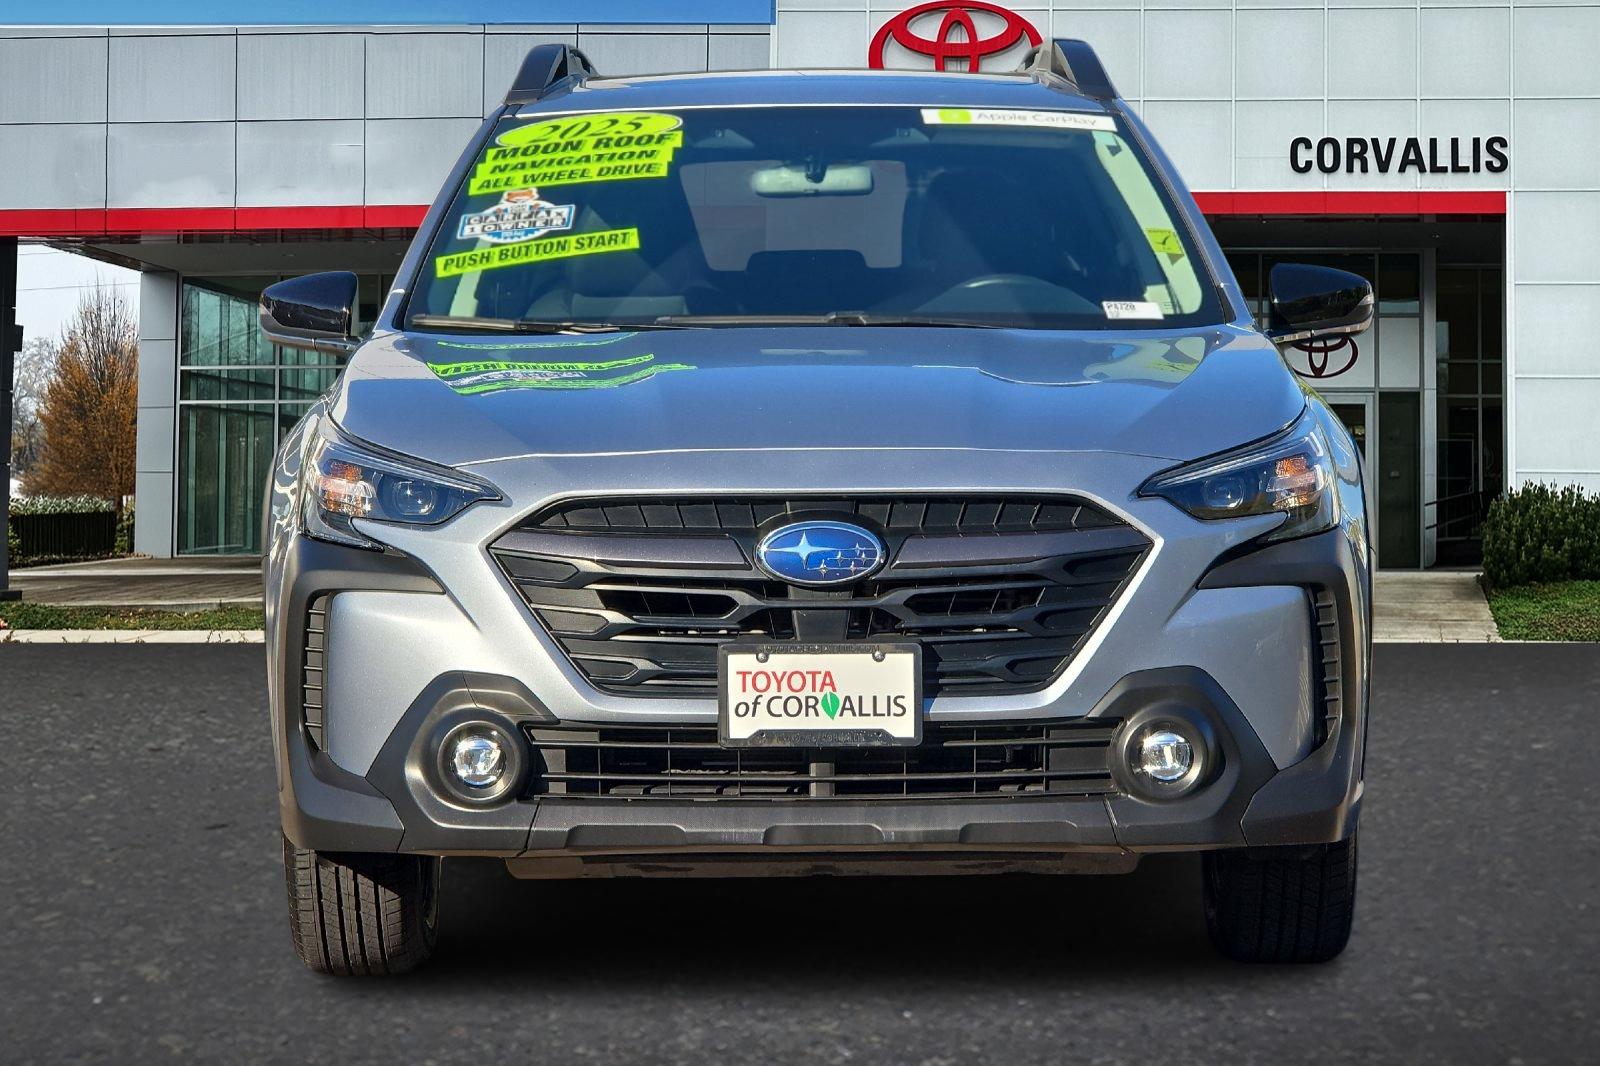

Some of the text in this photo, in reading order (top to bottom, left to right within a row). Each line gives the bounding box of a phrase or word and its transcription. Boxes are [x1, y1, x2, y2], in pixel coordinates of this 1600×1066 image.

[529, 116, 651, 143] 2025
[977, 113, 1097, 125] Apple CarPlay
[492, 132, 674, 161] MOON ROOF
[1290, 136, 1509, 174] CORVALLIS
[490, 149, 657, 174] NAVIGATION
[477, 162, 661, 190] ALL WHEEL DRIVE
[468, 208, 566, 225] CARFAX
[443, 230, 631, 272] PUSH BUTTON START
[736, 670, 837, 693] TOYOTA
[734, 694, 763, 718] of
